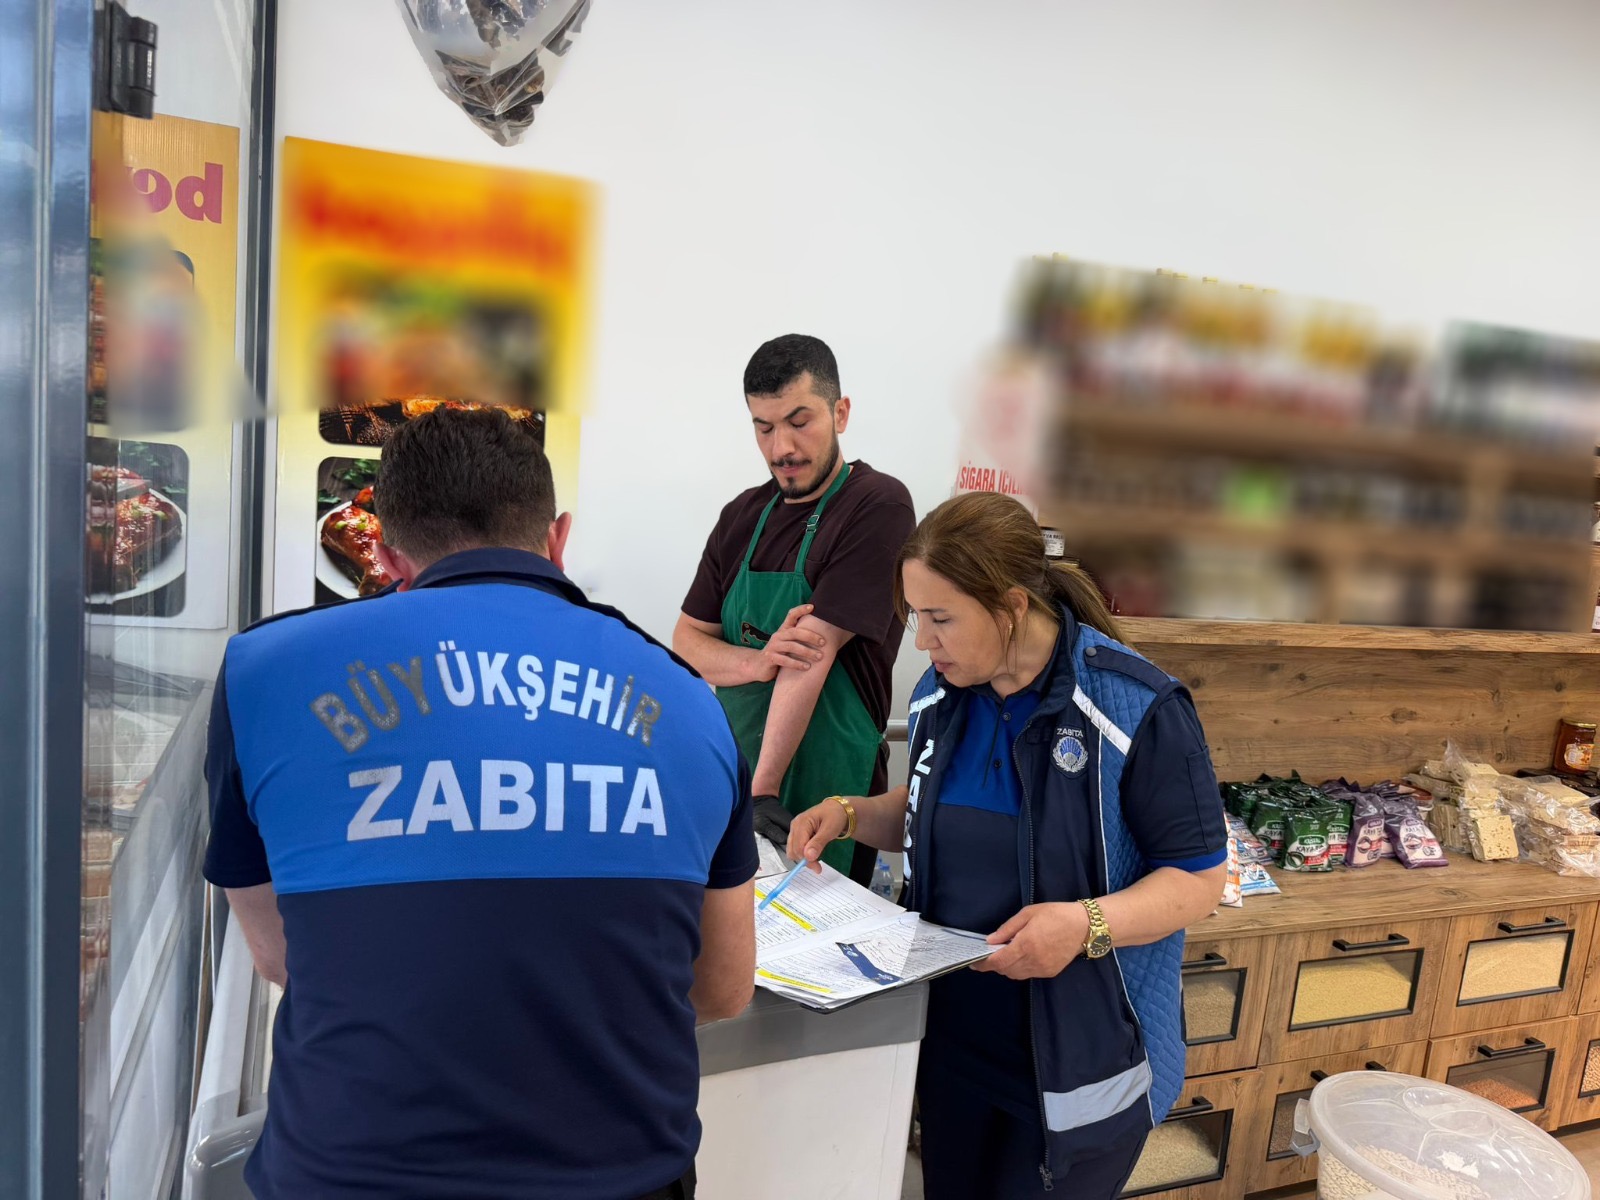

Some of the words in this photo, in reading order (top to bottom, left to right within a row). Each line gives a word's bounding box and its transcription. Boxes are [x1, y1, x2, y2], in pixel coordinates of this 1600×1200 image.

[959, 461, 996, 491] SİGARA
[309, 640, 662, 753] BÜYÜKŞEHİR
[1056, 727, 1084, 738] ZABITA
[346, 759, 668, 841] ZABITA
